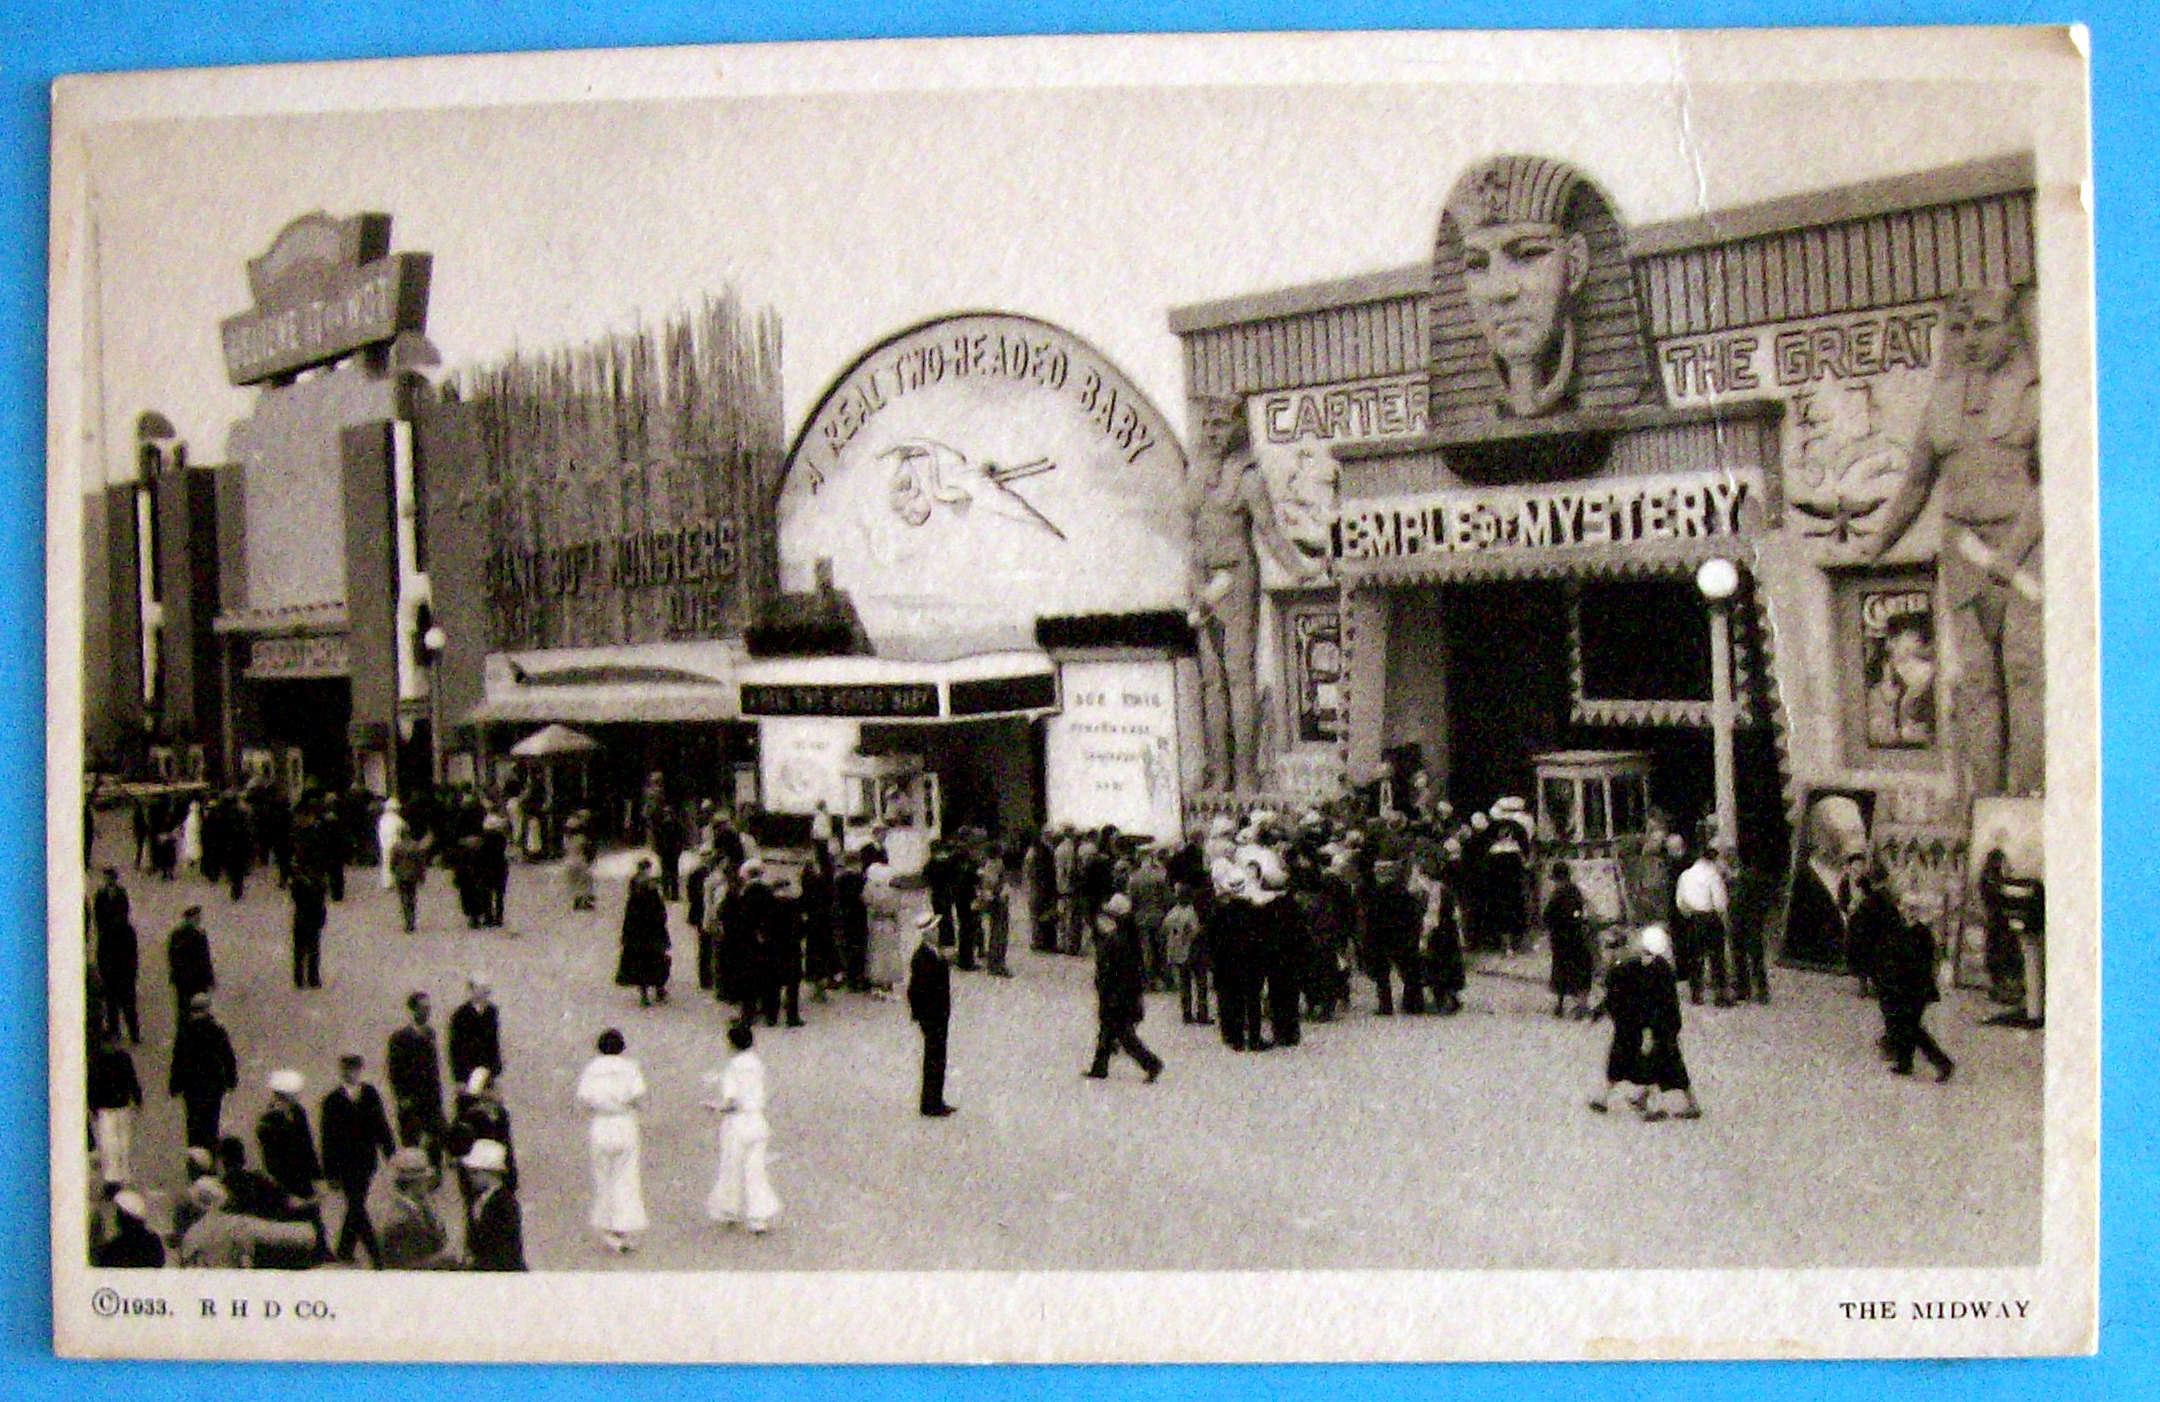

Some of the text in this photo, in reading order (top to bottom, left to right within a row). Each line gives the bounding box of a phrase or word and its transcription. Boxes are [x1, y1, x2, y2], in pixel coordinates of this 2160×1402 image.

[1665, 310, 1938, 397] THE GREAT
[824, 373, 887, 457] REAL
[1081, 366, 1155, 464] BABY
[1266, 382, 1430, 444] CARTER
[1517, 481, 1749, 548] MYSTERY
[200, 1298, 216, 1316] R
[231, 1298, 248, 1317] H
[265, 1300, 281, 1318] D
[295, 1300, 336, 1318] CO.
[1839, 1300, 2030, 1320] THE MIDWAY
